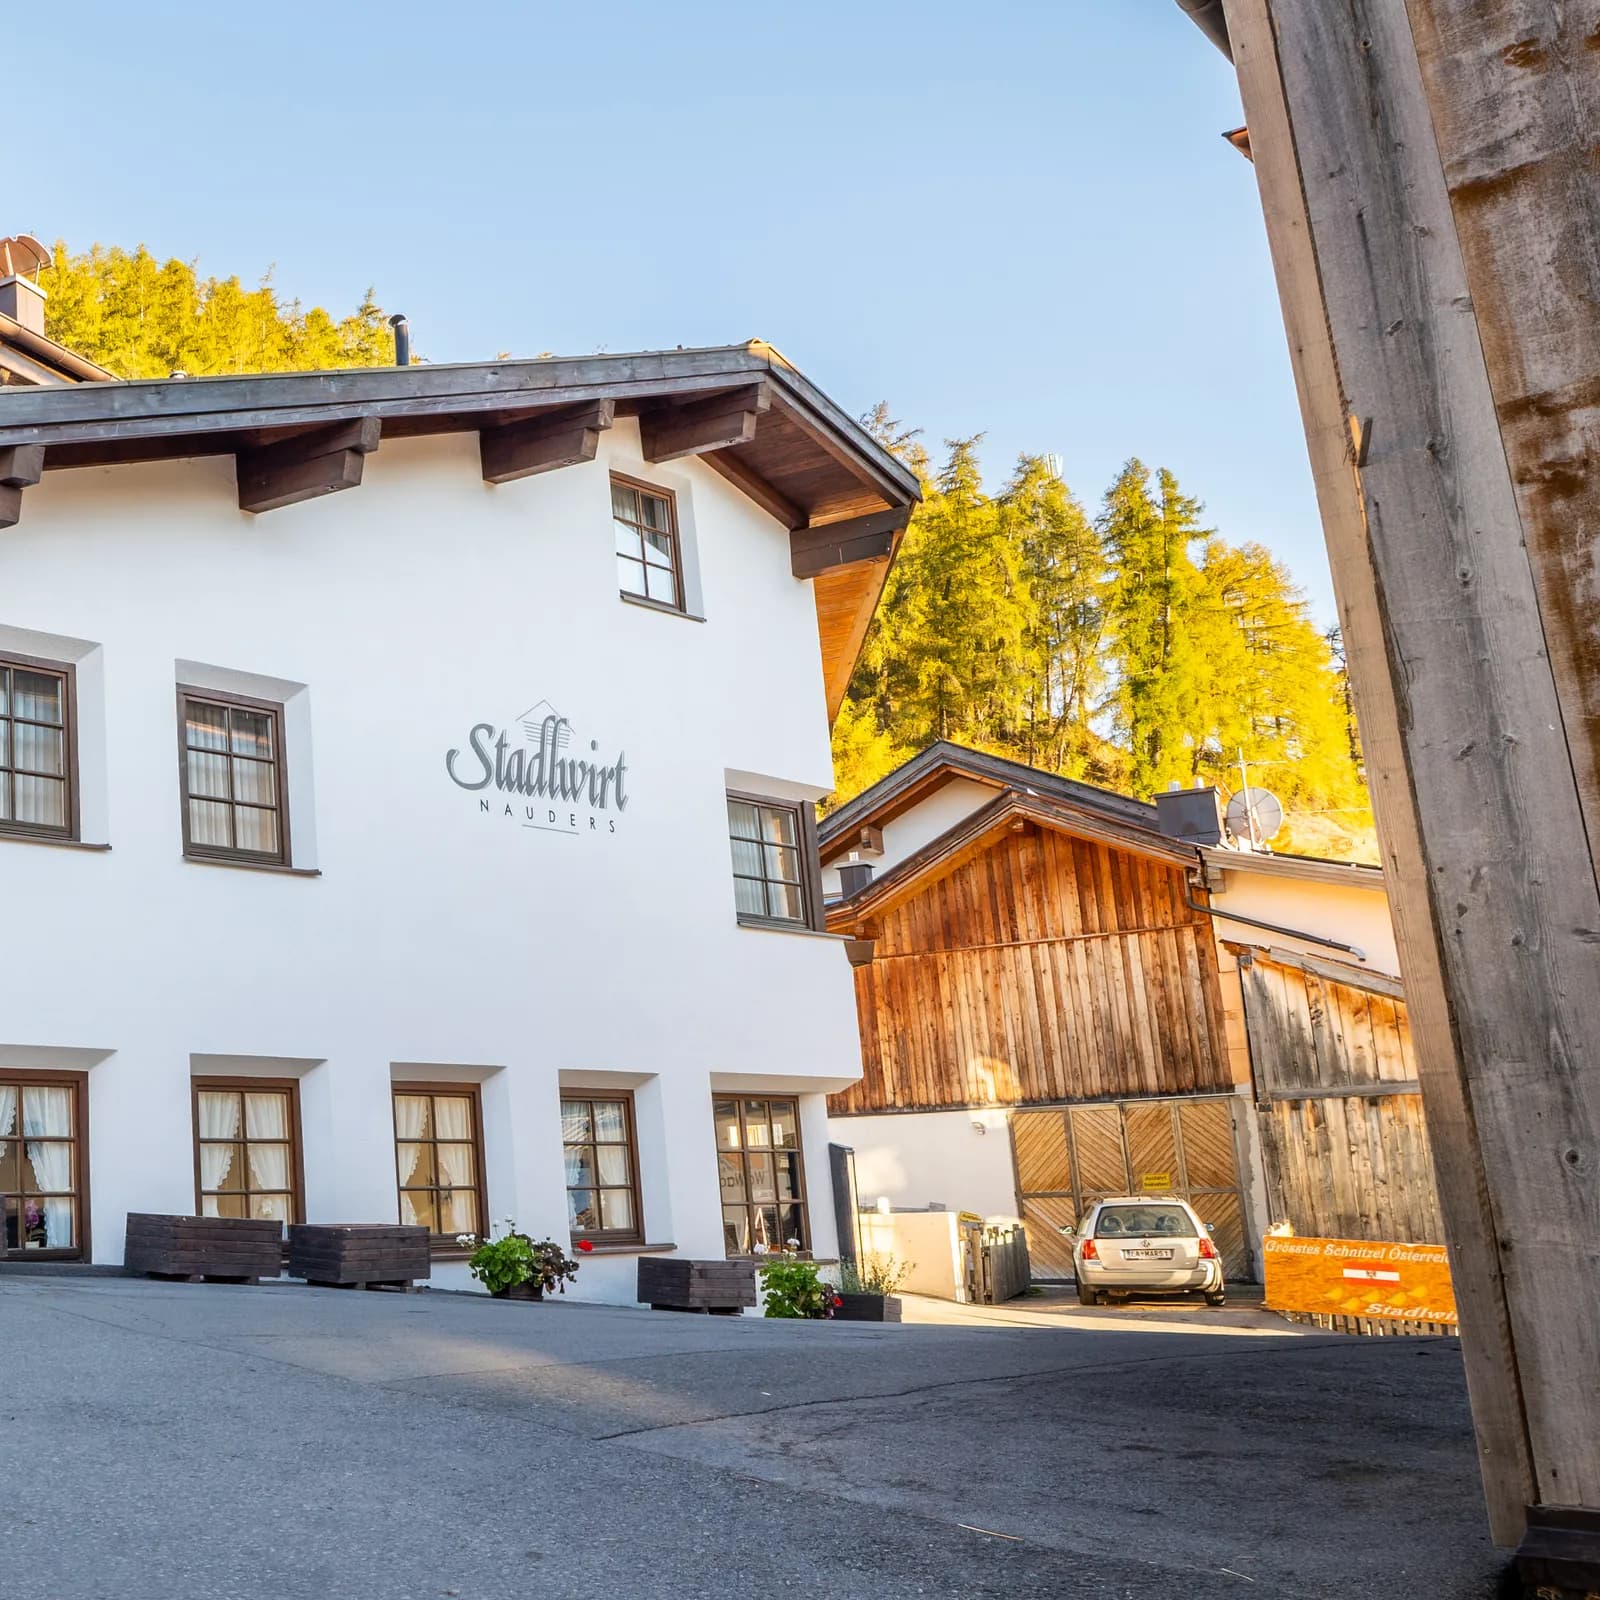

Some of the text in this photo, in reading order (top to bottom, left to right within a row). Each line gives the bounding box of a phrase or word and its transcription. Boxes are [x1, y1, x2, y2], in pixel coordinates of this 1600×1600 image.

[446, 715, 629, 812] Stadlwirt
[479, 799, 615, 833] NAUDERS
[1264, 1240, 1320, 1256] Grösstes
[1324, 1243, 1387, 1260] Schnitzel
